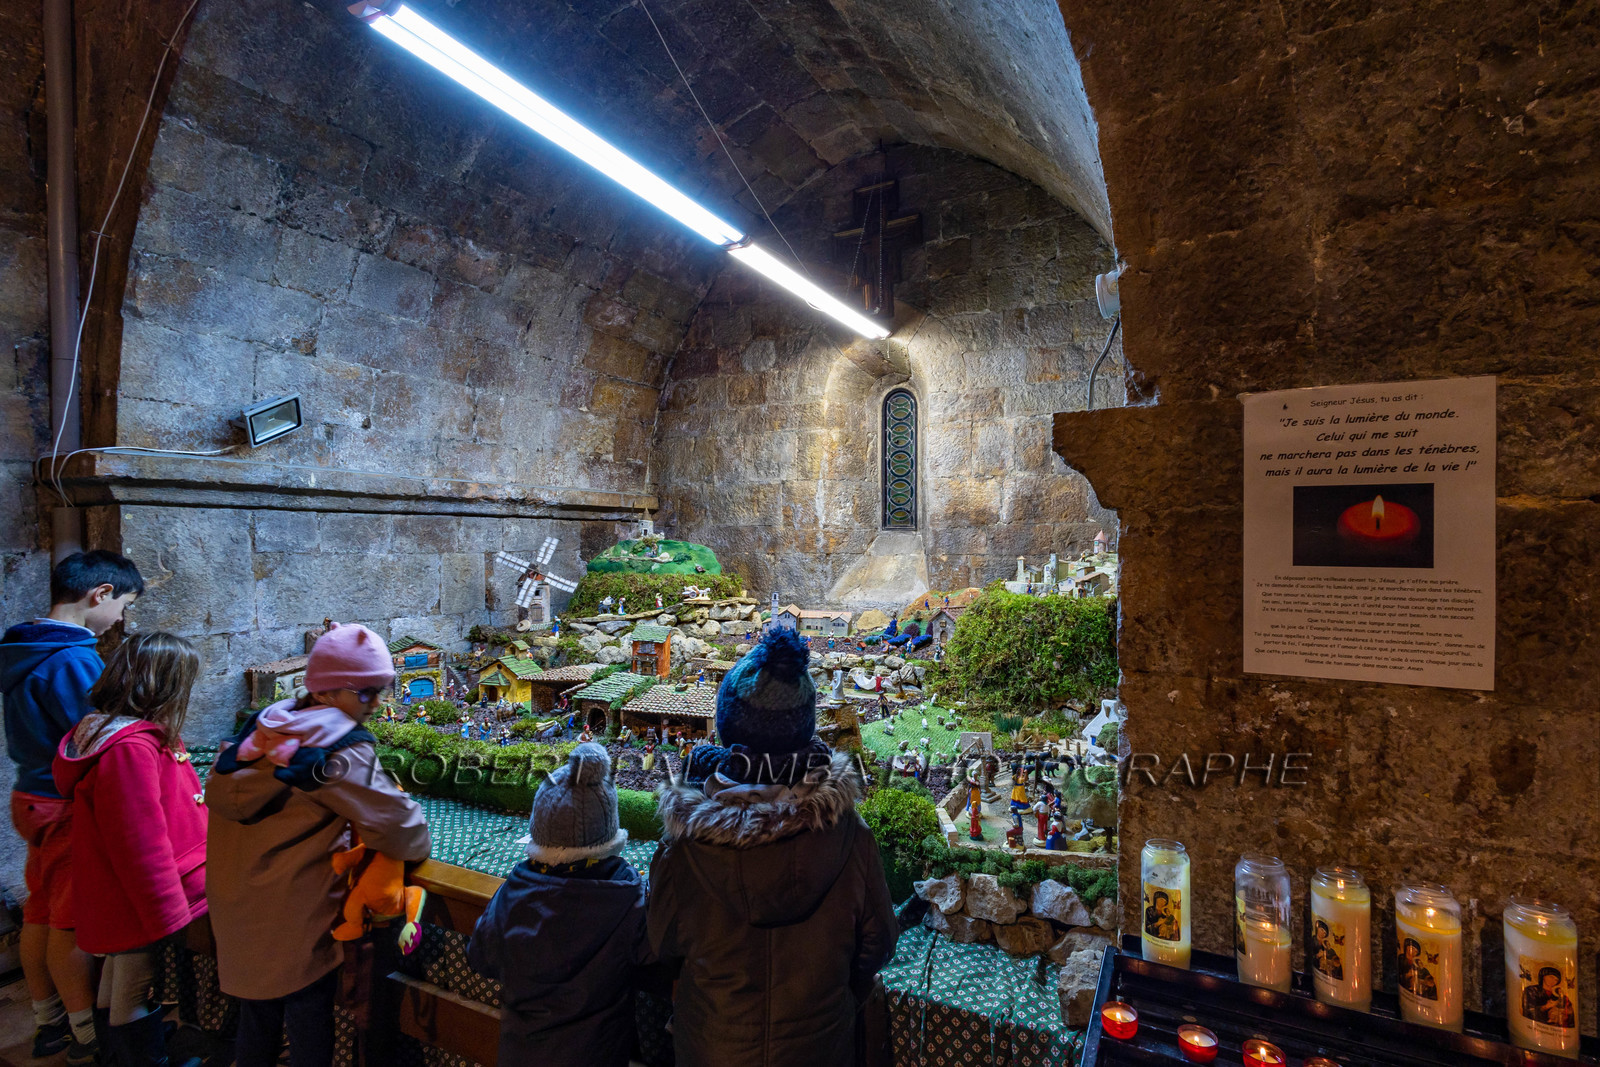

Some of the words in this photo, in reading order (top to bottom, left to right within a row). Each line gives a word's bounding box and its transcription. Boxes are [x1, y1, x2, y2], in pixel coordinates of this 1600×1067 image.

[1310, 399, 1347, 409] Seigneur
[1350, 396, 1378, 405] Jésus,
[1279, 418, 1298, 428] "Je
[1302, 416, 1325, 426] suis
[1329, 415, 1340, 424] la
[1345, 412, 1390, 424] lumière
[1394, 411, 1410, 421] du
[1414, 408, 1459, 420] monde.
[1316, 432, 1346, 442] Celui
[1348, 430, 1368, 443] qui
[1394, 428, 1419, 438] suit
[1277, 450, 1332, 460] marchera
[1335, 450, 1357, 460] pas
[1361, 447, 1390, 457] dans
[1394, 446, 1413, 456] les
[1419, 443, 1480, 454] ténèbres,
[1265, 467, 1291, 477] mais
[1295, 466, 1303, 476] il
[1337, 465, 1348, 475] la
[1353, 463, 1398, 474] lumière
[1403, 462, 1419, 473] de
[1424, 462, 1436, 472] la
[1442, 462, 1460, 471] vie
